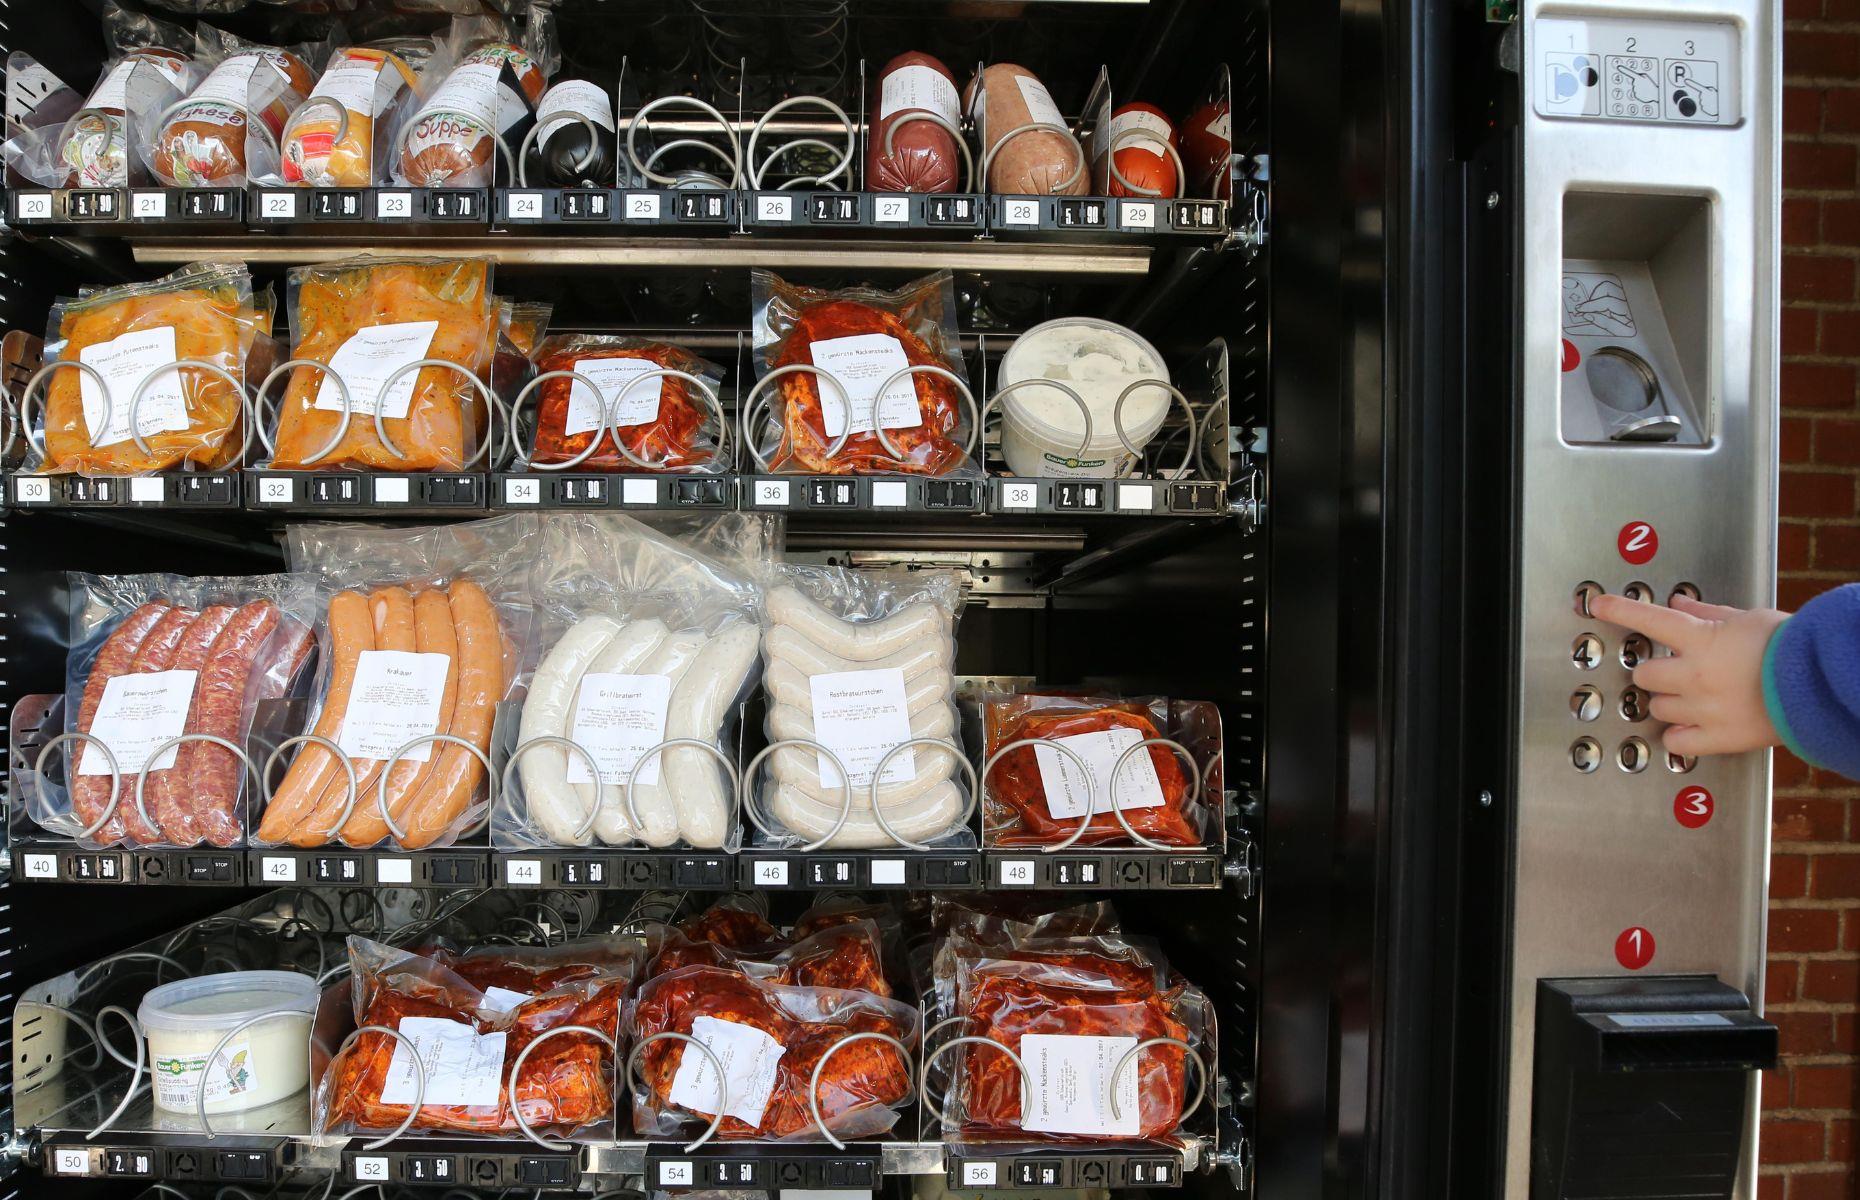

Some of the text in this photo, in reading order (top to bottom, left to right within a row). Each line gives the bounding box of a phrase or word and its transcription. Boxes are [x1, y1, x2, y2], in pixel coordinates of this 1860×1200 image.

[1568, 34, 1575, 49] 1
[1626, 37, 1637, 53] 2
[1684, 40, 1695, 56] 3
[416, 120, 473, 139] Suppe
[27, 200, 44, 213] 20
[141, 199, 158, 211] 21
[270, 199, 287, 212] 22
[386, 199, 403, 211] 23
[516, 200, 534, 212] 24
[634, 200, 652, 213] 25
[766, 202, 784, 215] 26
[883, 203, 901, 216] 27
[1013, 206, 1031, 219] 28
[1129, 208, 1147, 221] 29
[26, 484, 43, 496] 30
[268, 484, 285, 497] 32
[514, 485, 532, 497] 34
[763, 486, 781, 500] 36
[1012, 490, 1029, 502] 38
[1626, 525, 1650, 551] 2
[1577, 588, 1590, 616] 1
[1573, 639, 1639, 668] 4 5
[386, 667, 413, 677] Krakauer
[829, 688, 884, 698] Rostbratwürstchen
[1575, 691, 1639, 720] 7 8
[1573, 742, 1591, 770] C
[1684, 792, 1708, 815] 3
[33, 860, 50, 873] 40
[270, 863, 288, 876] 42
[515, 866, 533, 878] 44
[762, 867, 780, 879] 46
[1009, 866, 1026, 879] 48
[1628, 928, 1641, 958] 1
[65, 1156, 81, 1168] 50
[364, 1163, 381, 1175] 52
[668, 1168, 685, 1180] 54
[972, 1168, 989, 1180] 56
